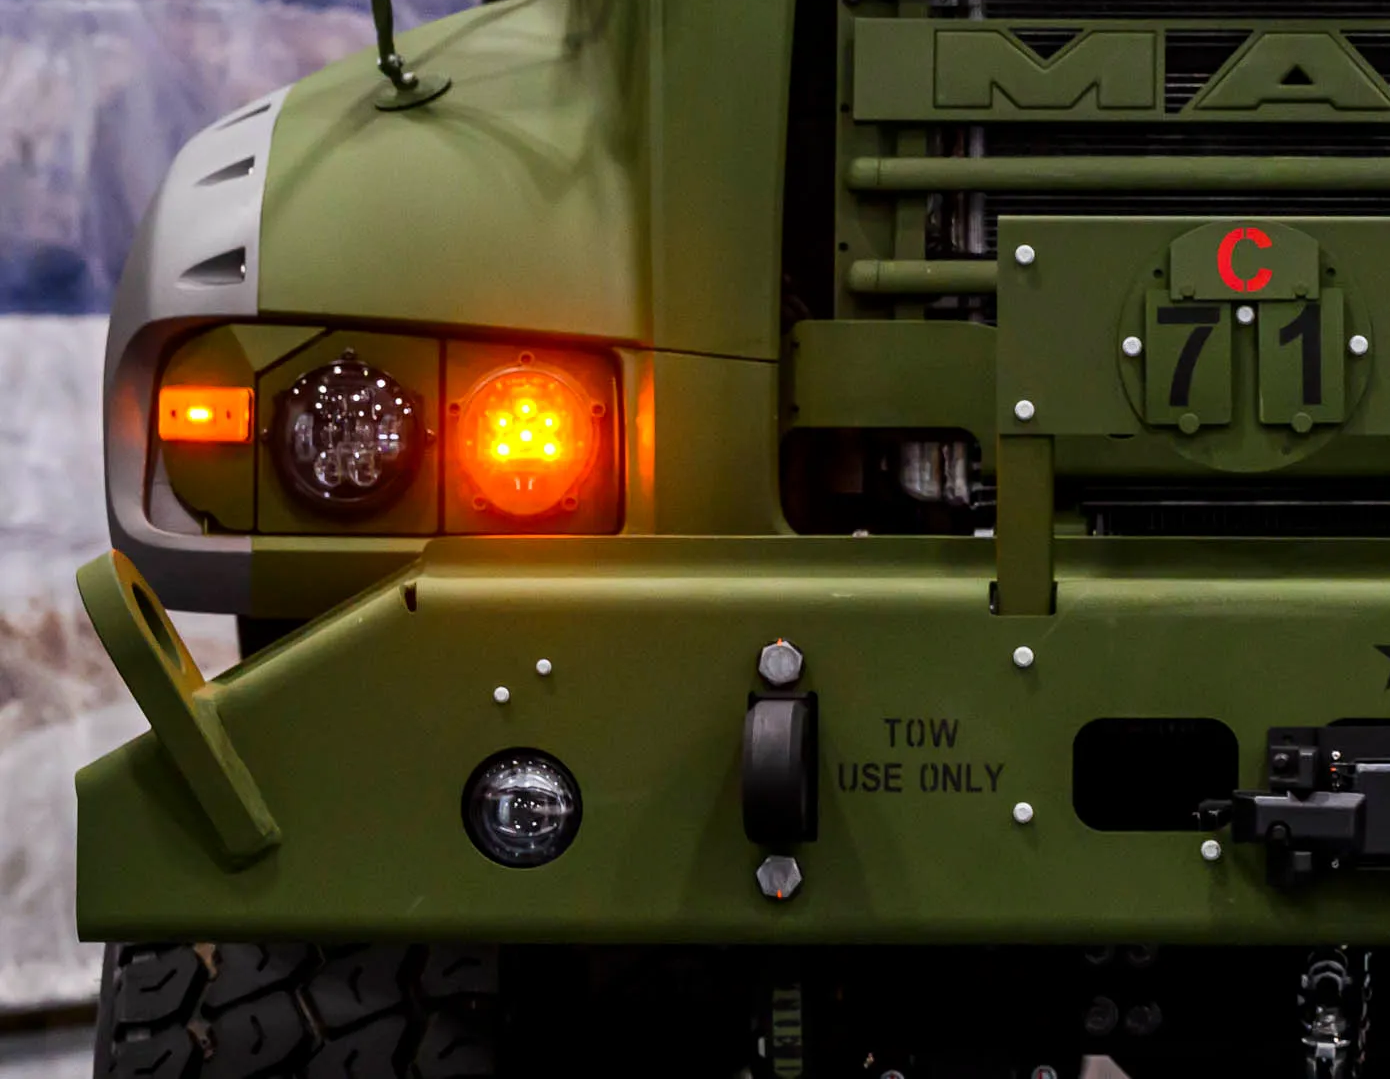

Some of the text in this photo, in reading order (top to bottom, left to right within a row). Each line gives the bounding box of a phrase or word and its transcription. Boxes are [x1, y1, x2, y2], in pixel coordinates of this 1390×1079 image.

[1217, 226, 1273, 292] C
[884, 718, 960, 748] TOW
[837, 762, 1005, 792] USE ONLY
